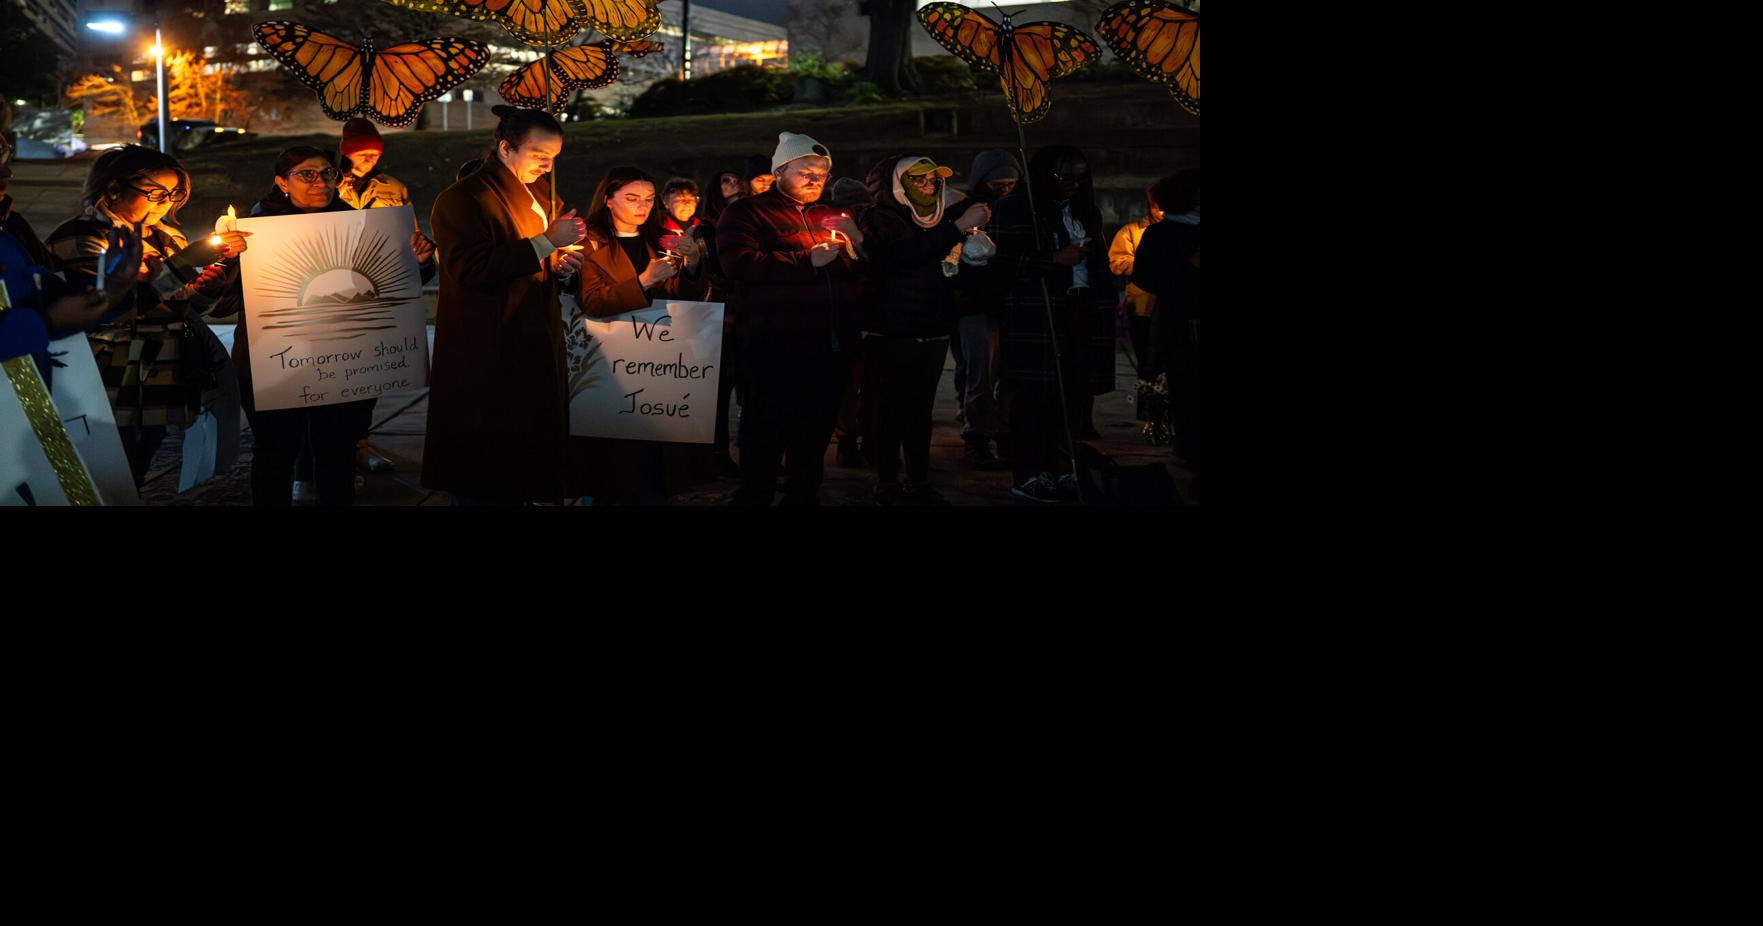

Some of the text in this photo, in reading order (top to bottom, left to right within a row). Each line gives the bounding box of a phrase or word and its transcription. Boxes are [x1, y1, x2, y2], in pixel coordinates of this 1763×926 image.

[631, 315, 675, 342] We
[270, 336, 419, 369] Tomorrow should
[612, 352, 714, 379] remember
[317, 367, 337, 381] be
[299, 379, 410, 404] for everyone
[618, 388, 690, 418] Josué
